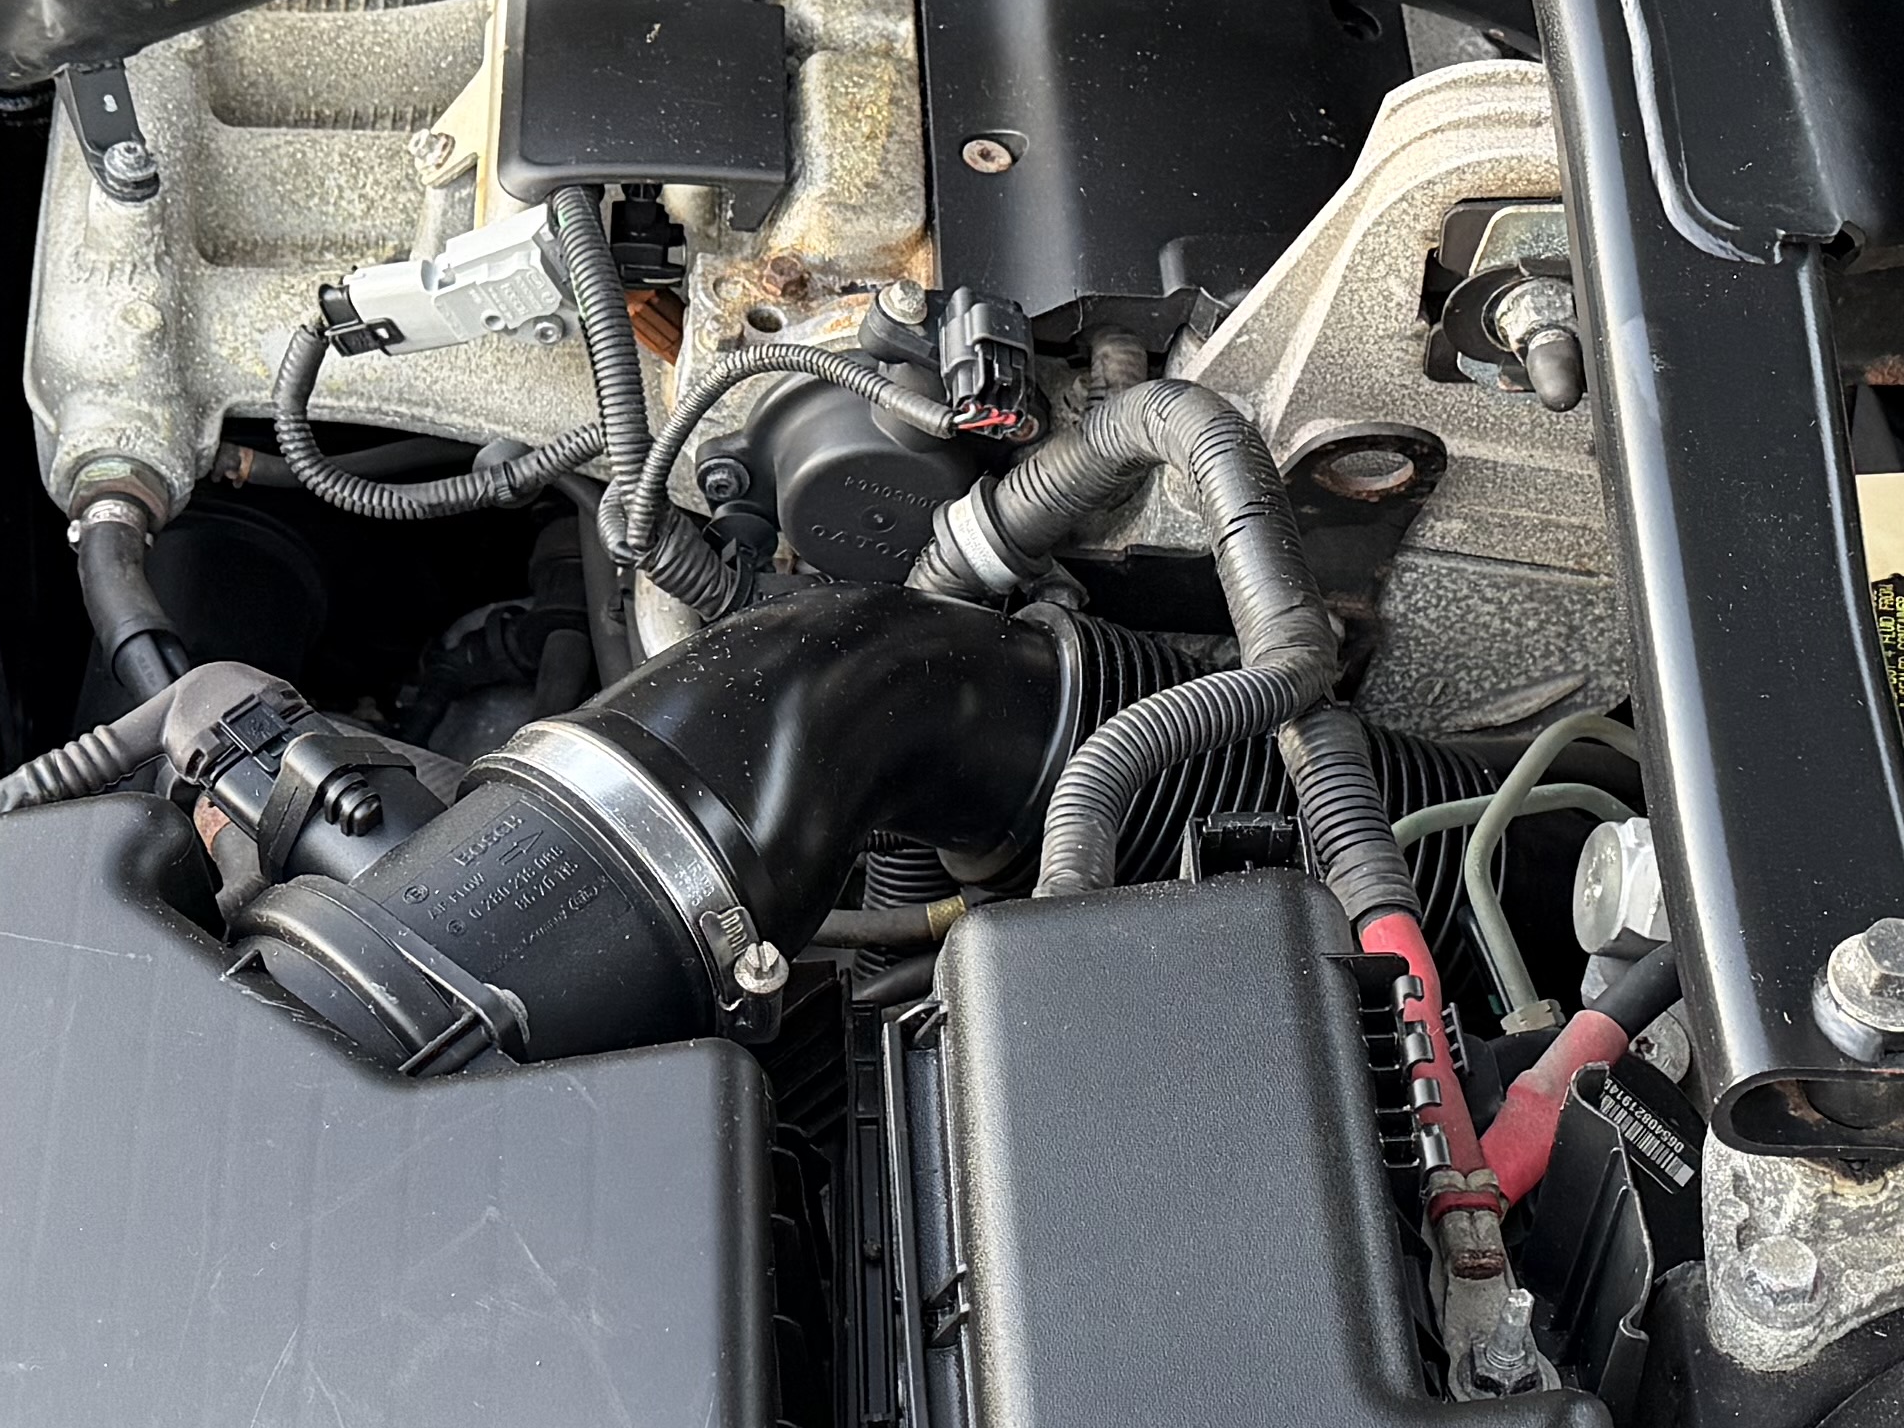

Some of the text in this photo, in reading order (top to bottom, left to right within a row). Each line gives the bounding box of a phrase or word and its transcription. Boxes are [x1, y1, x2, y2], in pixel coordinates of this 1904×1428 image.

[1877, 584, 1894, 610] FROM
[1879, 616, 1895, 644] FLUID
[452, 813, 526, 869] BOSCH
[447, 871, 486, 904] FLOW
[480, 883, 511, 913] 280
